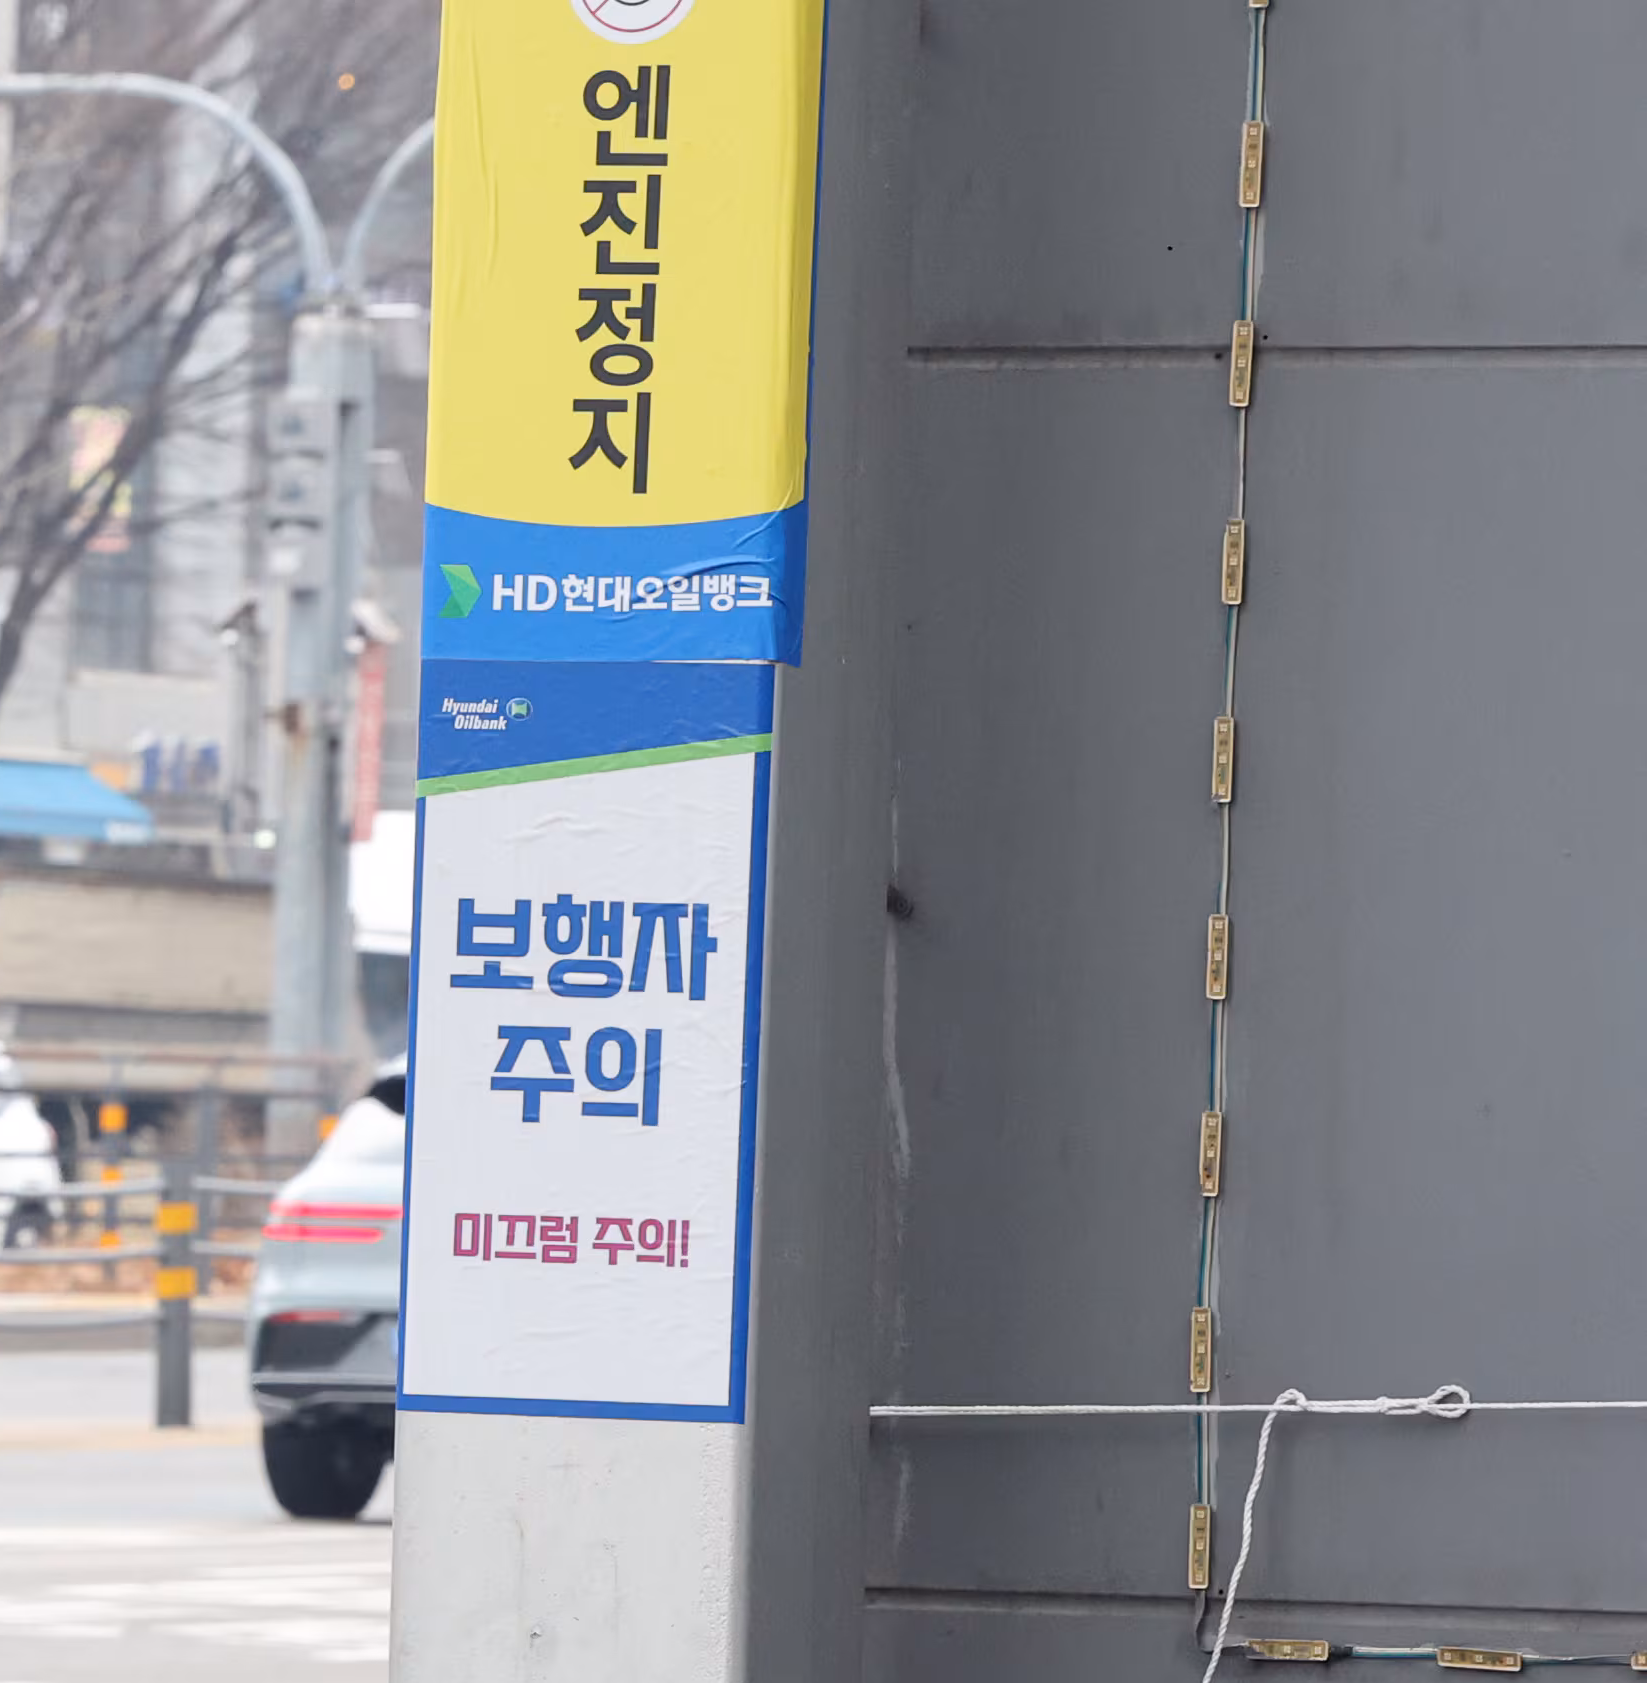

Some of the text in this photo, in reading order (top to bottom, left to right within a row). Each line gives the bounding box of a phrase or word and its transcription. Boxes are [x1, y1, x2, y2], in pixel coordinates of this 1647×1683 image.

[568, 64, 671, 494] 엔진정지
[492, 573, 773, 613] HD현대오일뱅크
[441, 697, 499, 718] Hyundai
[454, 713, 507, 731] Oilbank
[449, 893, 718, 1001] 보행자
[490, 1025, 663, 1127] 주의
[453, 1212, 690, 1268] 미끄럼 주의!
